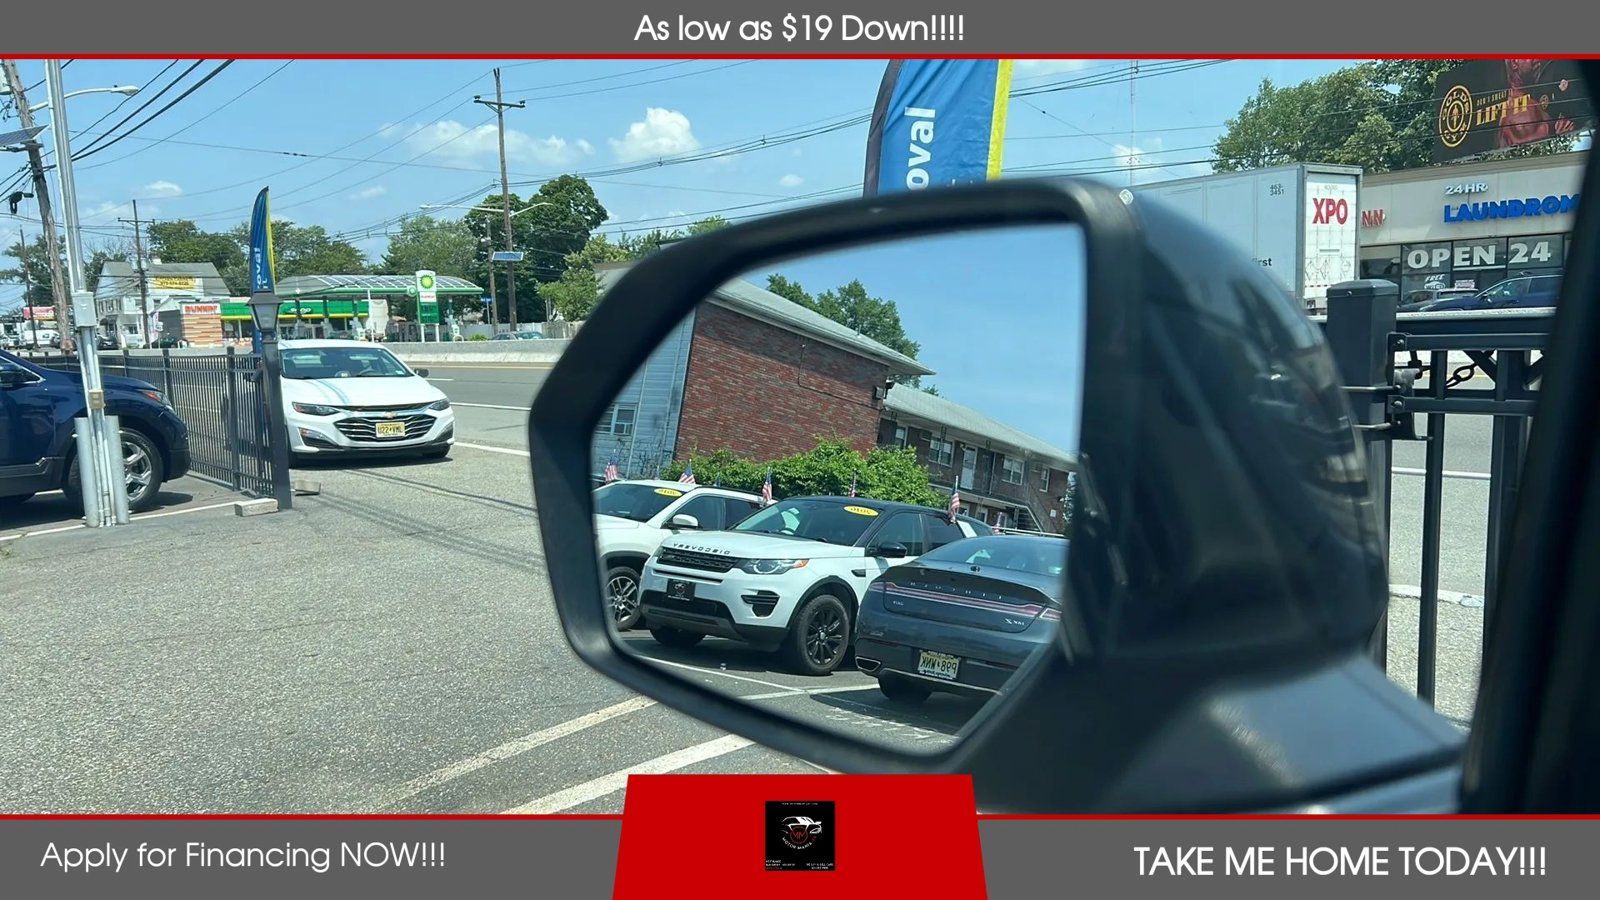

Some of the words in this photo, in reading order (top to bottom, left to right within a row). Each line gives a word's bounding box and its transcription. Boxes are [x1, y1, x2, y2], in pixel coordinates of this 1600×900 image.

[1312, 197, 1348, 225] XPO
[1407, 244, 1496, 269] OPEN
[1508, 241, 1551, 264] 24
